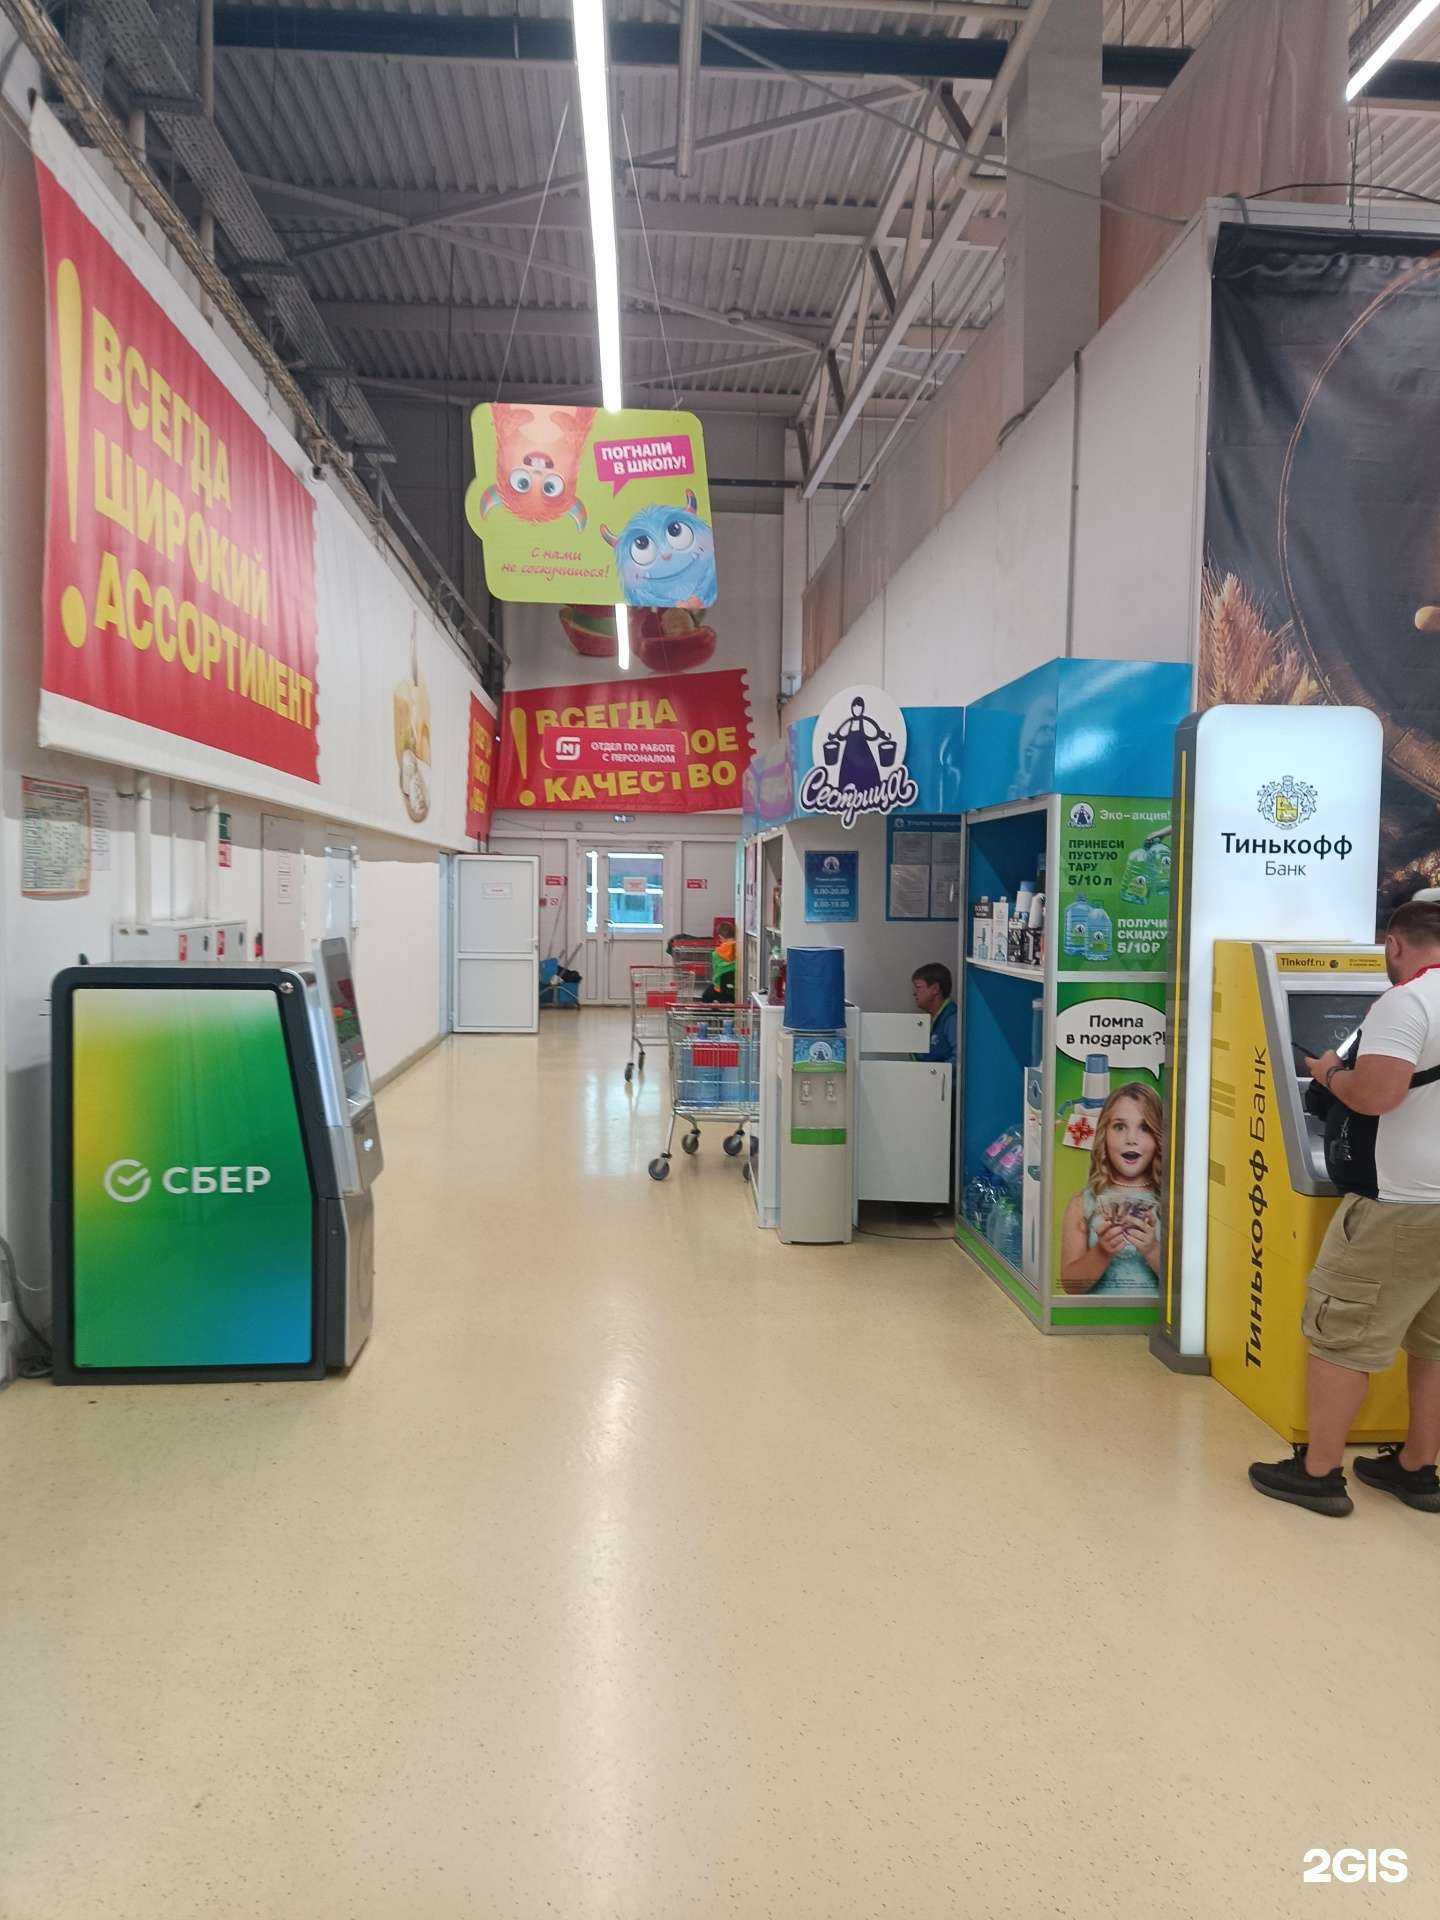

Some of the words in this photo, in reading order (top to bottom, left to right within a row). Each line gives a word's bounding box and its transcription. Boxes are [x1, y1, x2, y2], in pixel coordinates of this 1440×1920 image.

[92, 306, 232, 512] ВСЕГДА
[601, 441, 673, 461] ПОГНАЛИ
[613, 460, 626, 475] В
[628, 456, 687, 474] ШКОЛУ!
[93, 428, 269, 626] ШИРОКИЙ
[531, 547, 541, 558] С
[543, 551, 582, 561] нами
[501, 563, 516, 573] не
[93, 550, 313, 730] АССОРТИМЕНТ
[535, 698, 679, 735] ВСЕГДА
[590, 742, 622, 752] ОТДЕЛ
[623, 743, 639, 752] ПО
[640, 744, 677, 753] РАБОТЕ
[601, 754, 609, 762] С
[611, 754, 676, 764] ПЕРСОНАЛОМ
[800, 767, 917, 826] Сестрица
[1068, 839, 1125, 849] ПРИНЕСИ
[1221, 832, 1353, 859] Тинькофф
[1068, 851, 1118, 861] ПУСТУЮ
[1069, 862, 1098, 872] ТАРУ
[1265, 860, 1306, 876] Банк
[1117, 918, 1168, 928] ПОЛУЧИ
[1117, 929, 1168, 941] СКИДКУ
[1280, 957, 1326, 967] Tinkoff.ru
[1089, 1015, 1144, 1028] Помпа
[1066, 1034, 1075, 1044] в
[1250, 1046, 1266, 1143] Банк
[162, 1166, 272, 1194] СБЕР
[1245, 1149, 1268, 1370] Тинькофф
